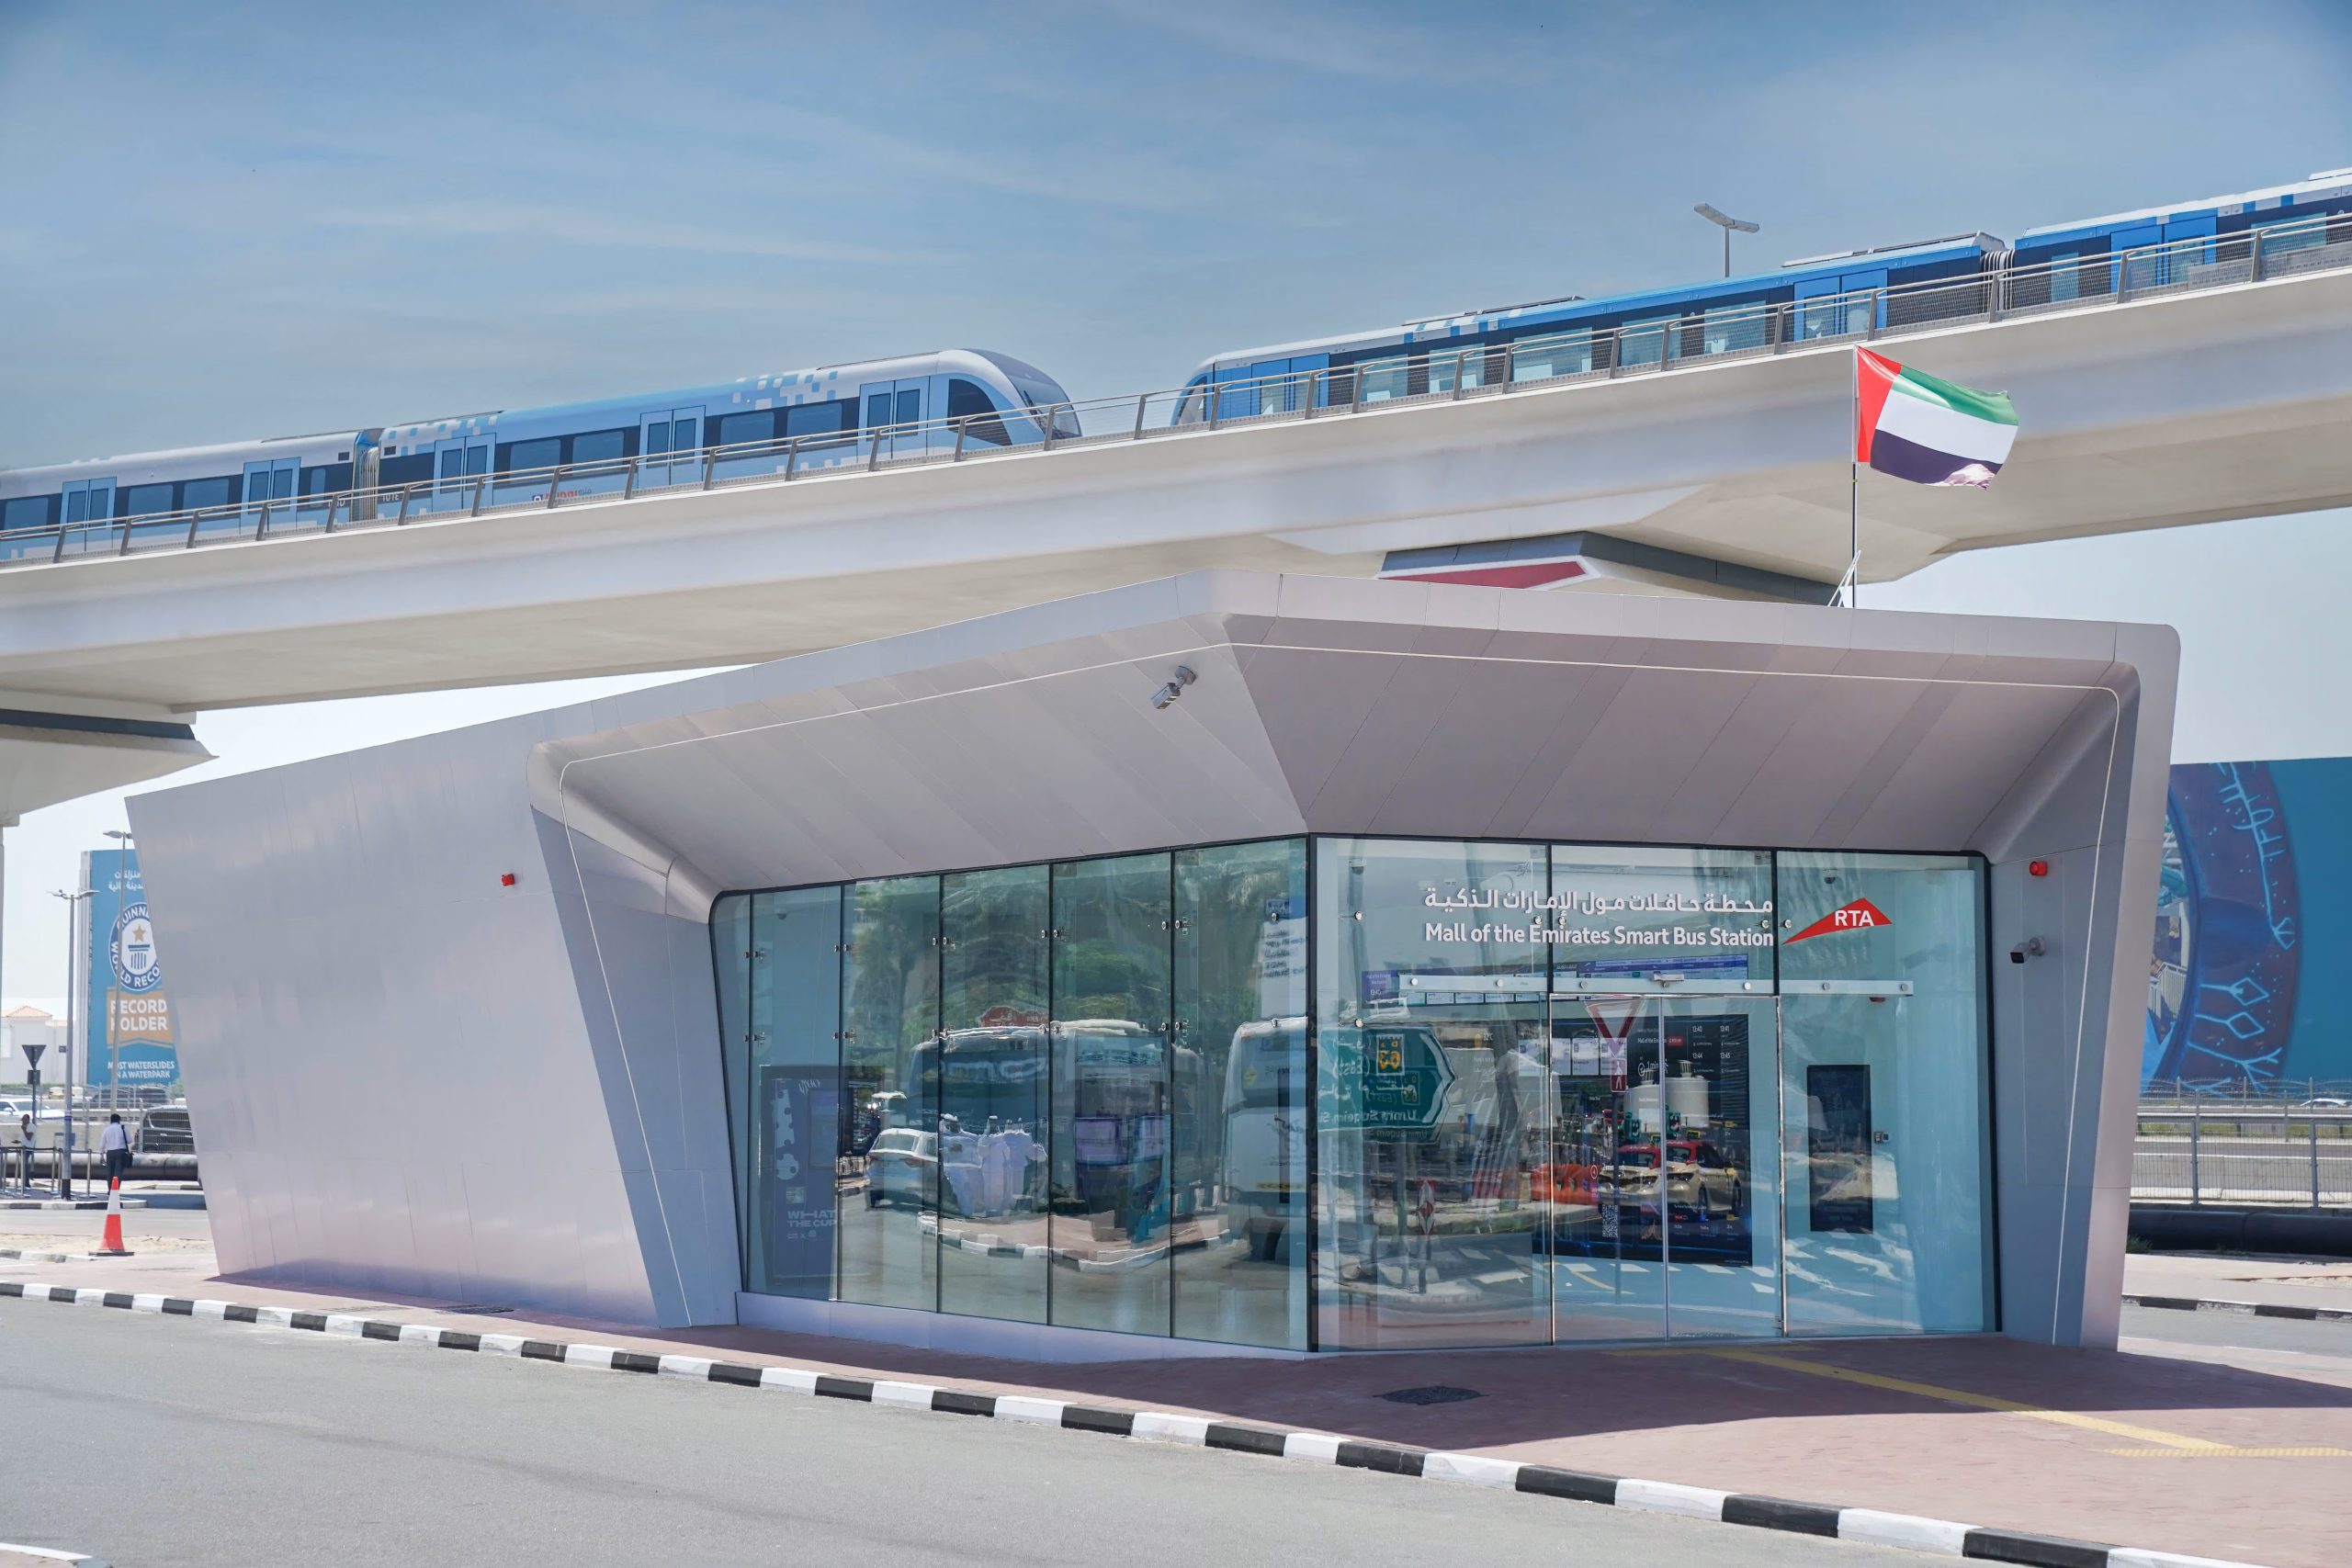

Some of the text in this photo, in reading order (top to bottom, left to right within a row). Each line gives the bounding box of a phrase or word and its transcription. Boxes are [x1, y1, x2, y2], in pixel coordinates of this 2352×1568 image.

[1424, 886, 1498, 913] الذكية
[1581, 891, 1625, 916] مول
[1629, 893, 1700, 912] حافلات
[1703, 892, 1773, 913] محطة
[1834, 909, 1875, 927] RTA
[1425, 922, 1774, 946] Mall of the Emirates Smart Bus Station
[128, 1060, 175, 1069] WATERSLIDES
[129, 1070, 171, 1078] WATERPARK
